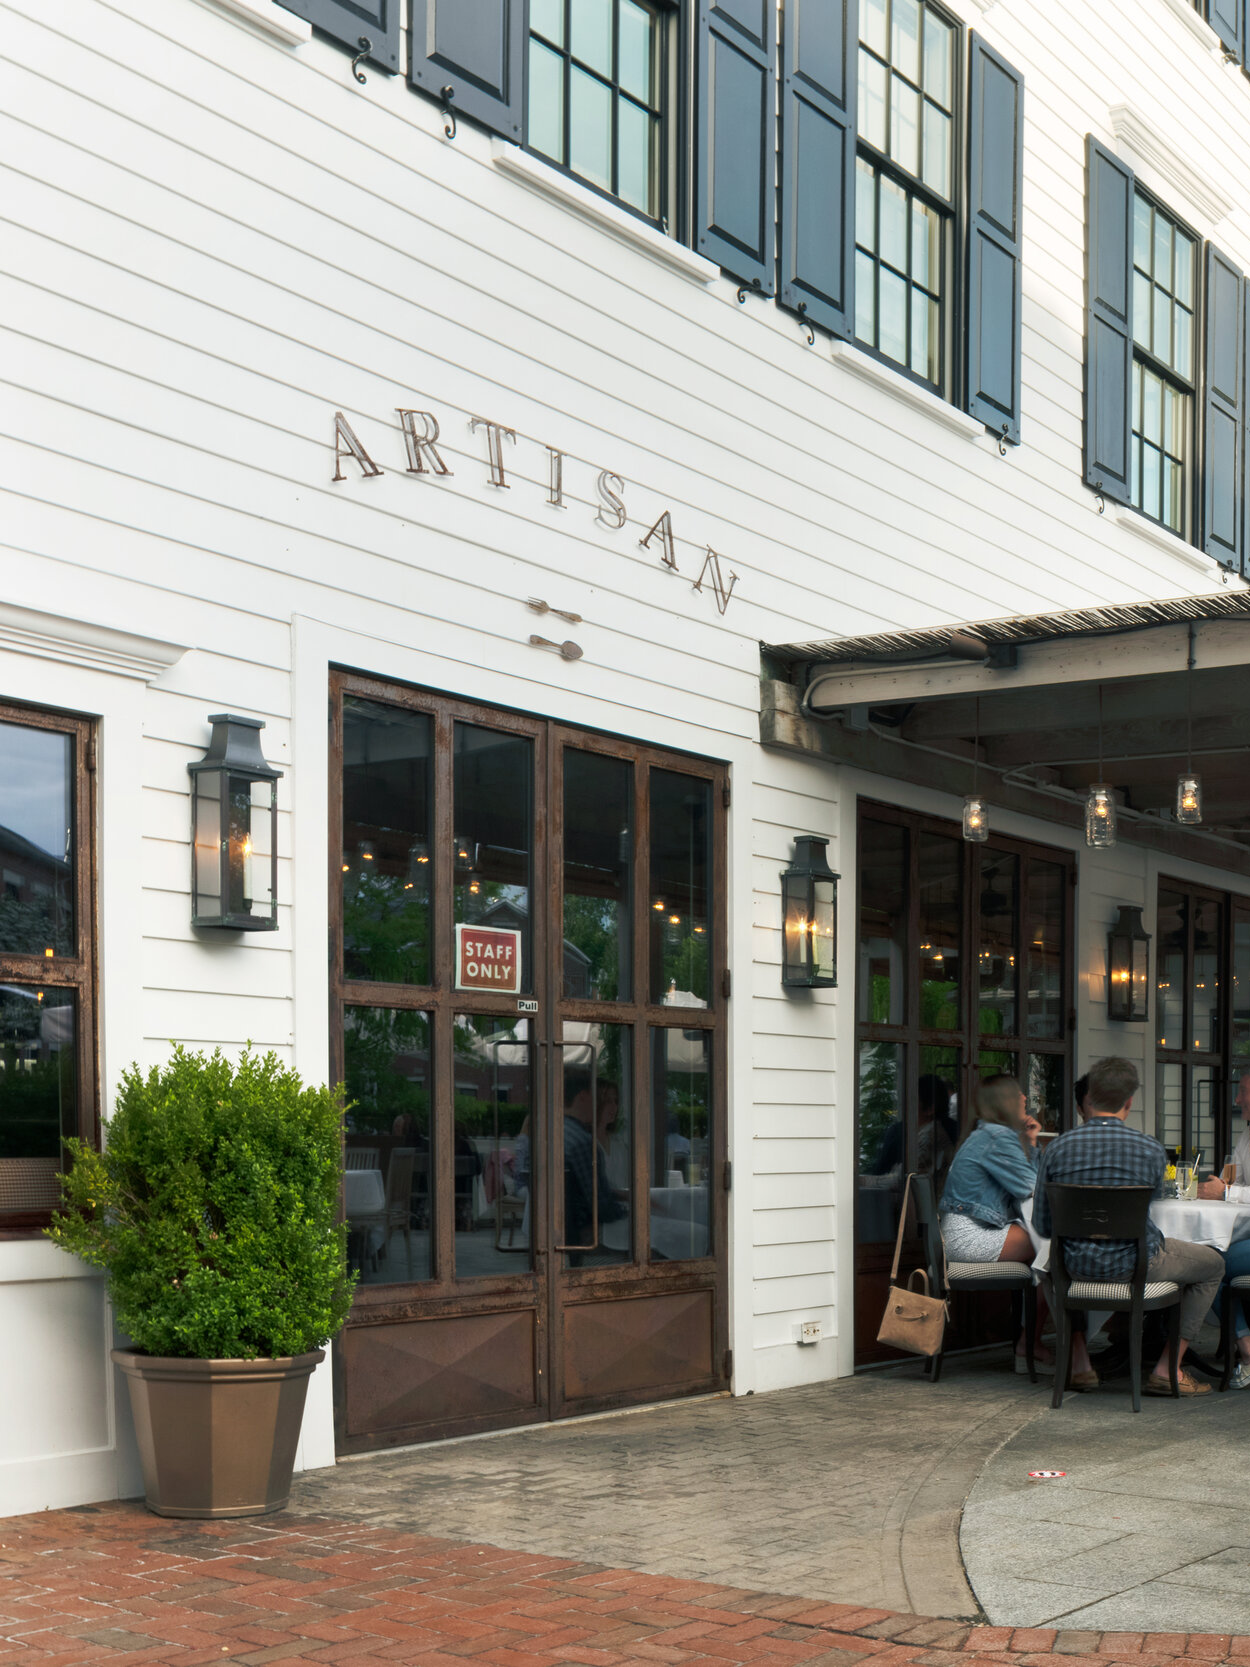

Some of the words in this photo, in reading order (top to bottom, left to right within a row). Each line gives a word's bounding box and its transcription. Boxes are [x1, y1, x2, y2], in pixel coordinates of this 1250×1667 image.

[332, 408, 740, 616] ARTISAN
[465, 941, 512, 960] STAFF
[467, 962, 511, 980] ONLY
[518, 1001, 537, 1011] Pull
